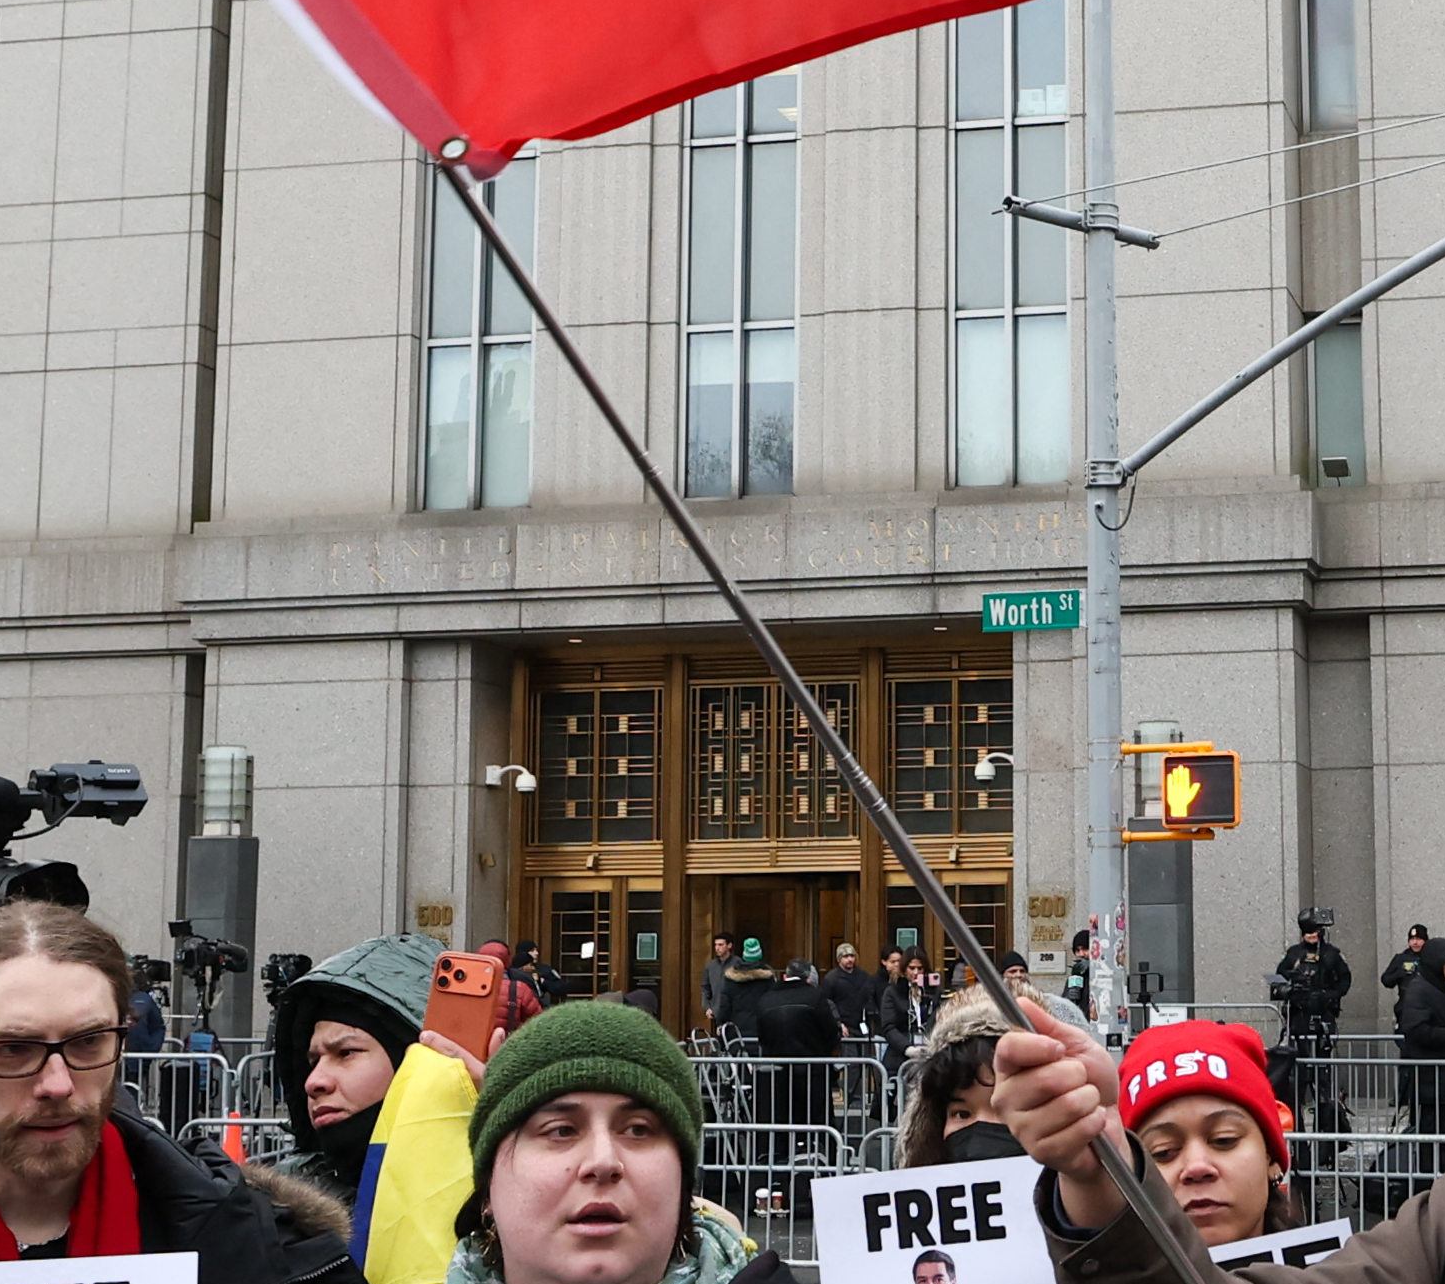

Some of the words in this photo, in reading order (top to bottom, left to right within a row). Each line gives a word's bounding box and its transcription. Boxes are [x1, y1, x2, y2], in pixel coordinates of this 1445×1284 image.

[808, 541, 957, 568] COURT
[989, 597, 1054, 628] Worth
[1059, 591, 1075, 612] St
[418, 905, 453, 926] 500
[1028, 896, 1066, 917] 500
[1128, 1050, 1229, 1106] FRSO
[863, 1181, 1007, 1253] FREE
